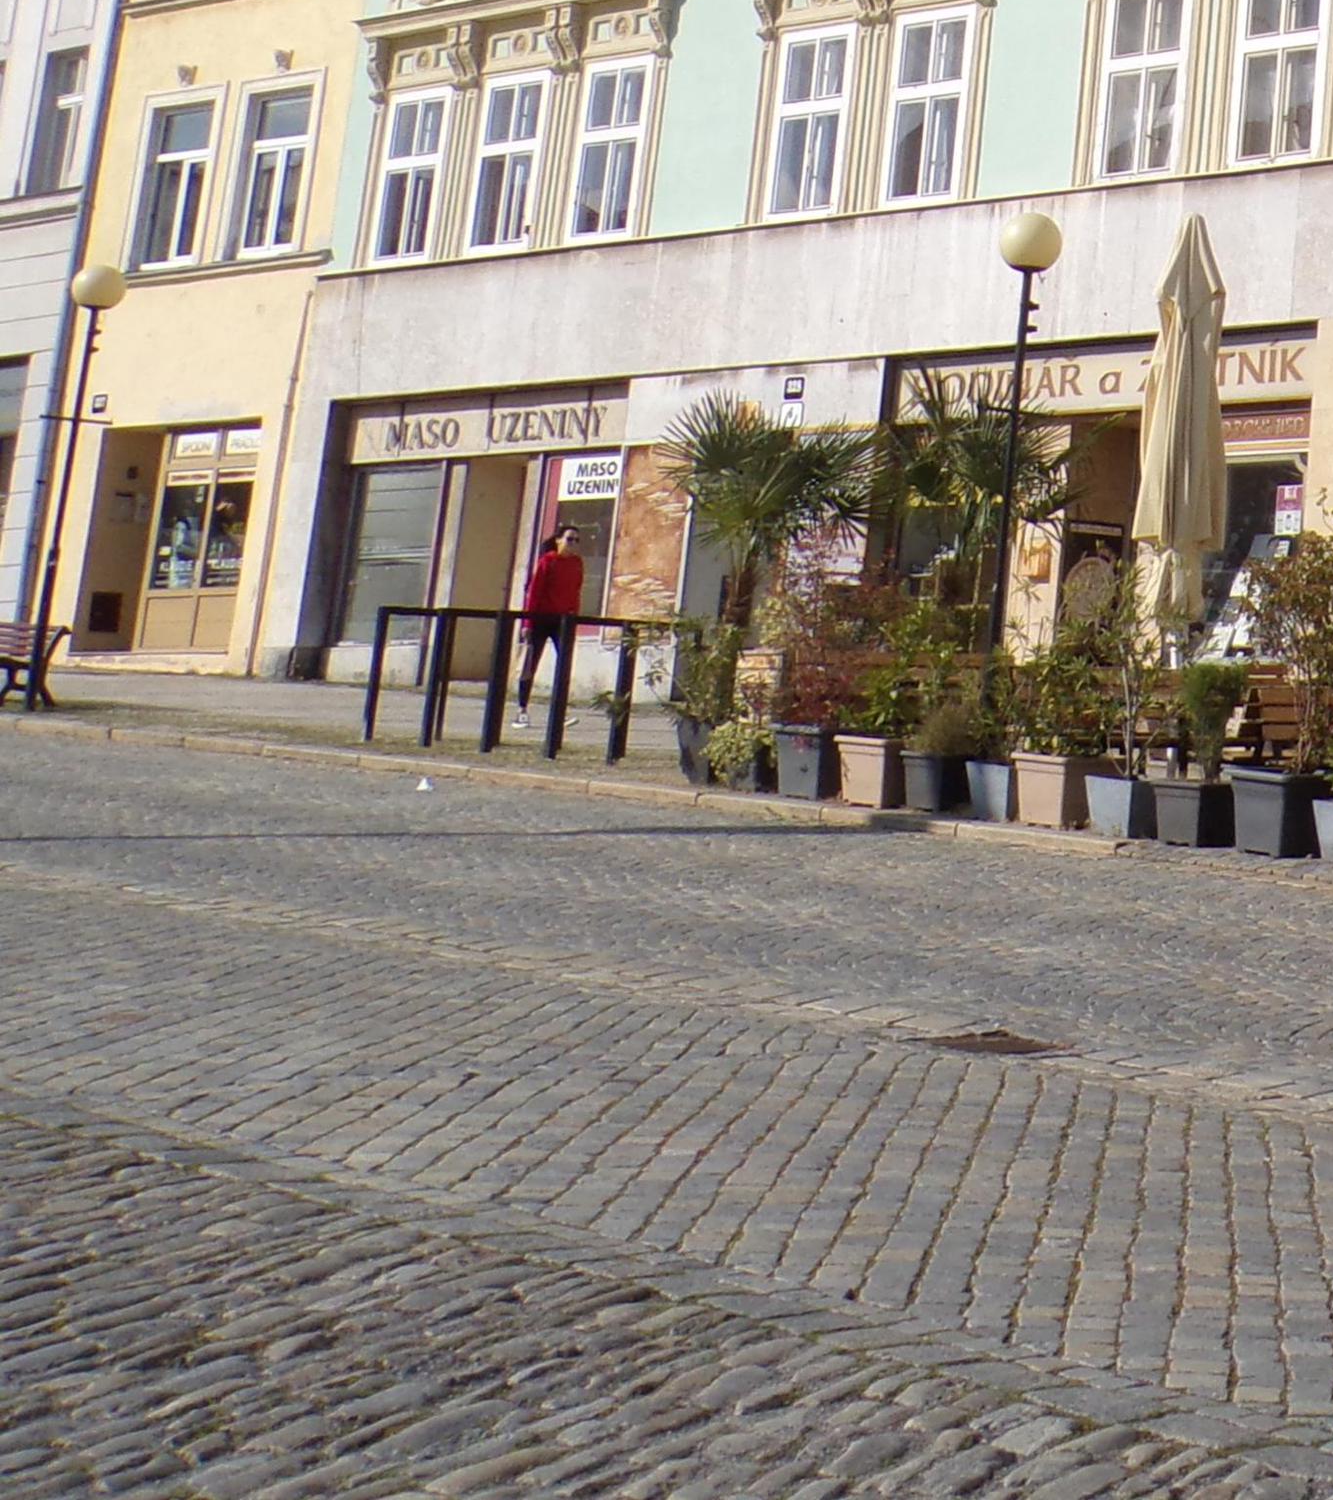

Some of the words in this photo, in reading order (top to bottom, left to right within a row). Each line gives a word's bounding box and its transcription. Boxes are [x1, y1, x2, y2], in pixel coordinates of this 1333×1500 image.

[1098, 368, 1123, 395] a
[1137, 338, 1306, 393] TNÍK
[385, 417, 461, 453] MASO
[487, 405, 608, 445] UZENINY
[576, 460, 618, 478] MASO
